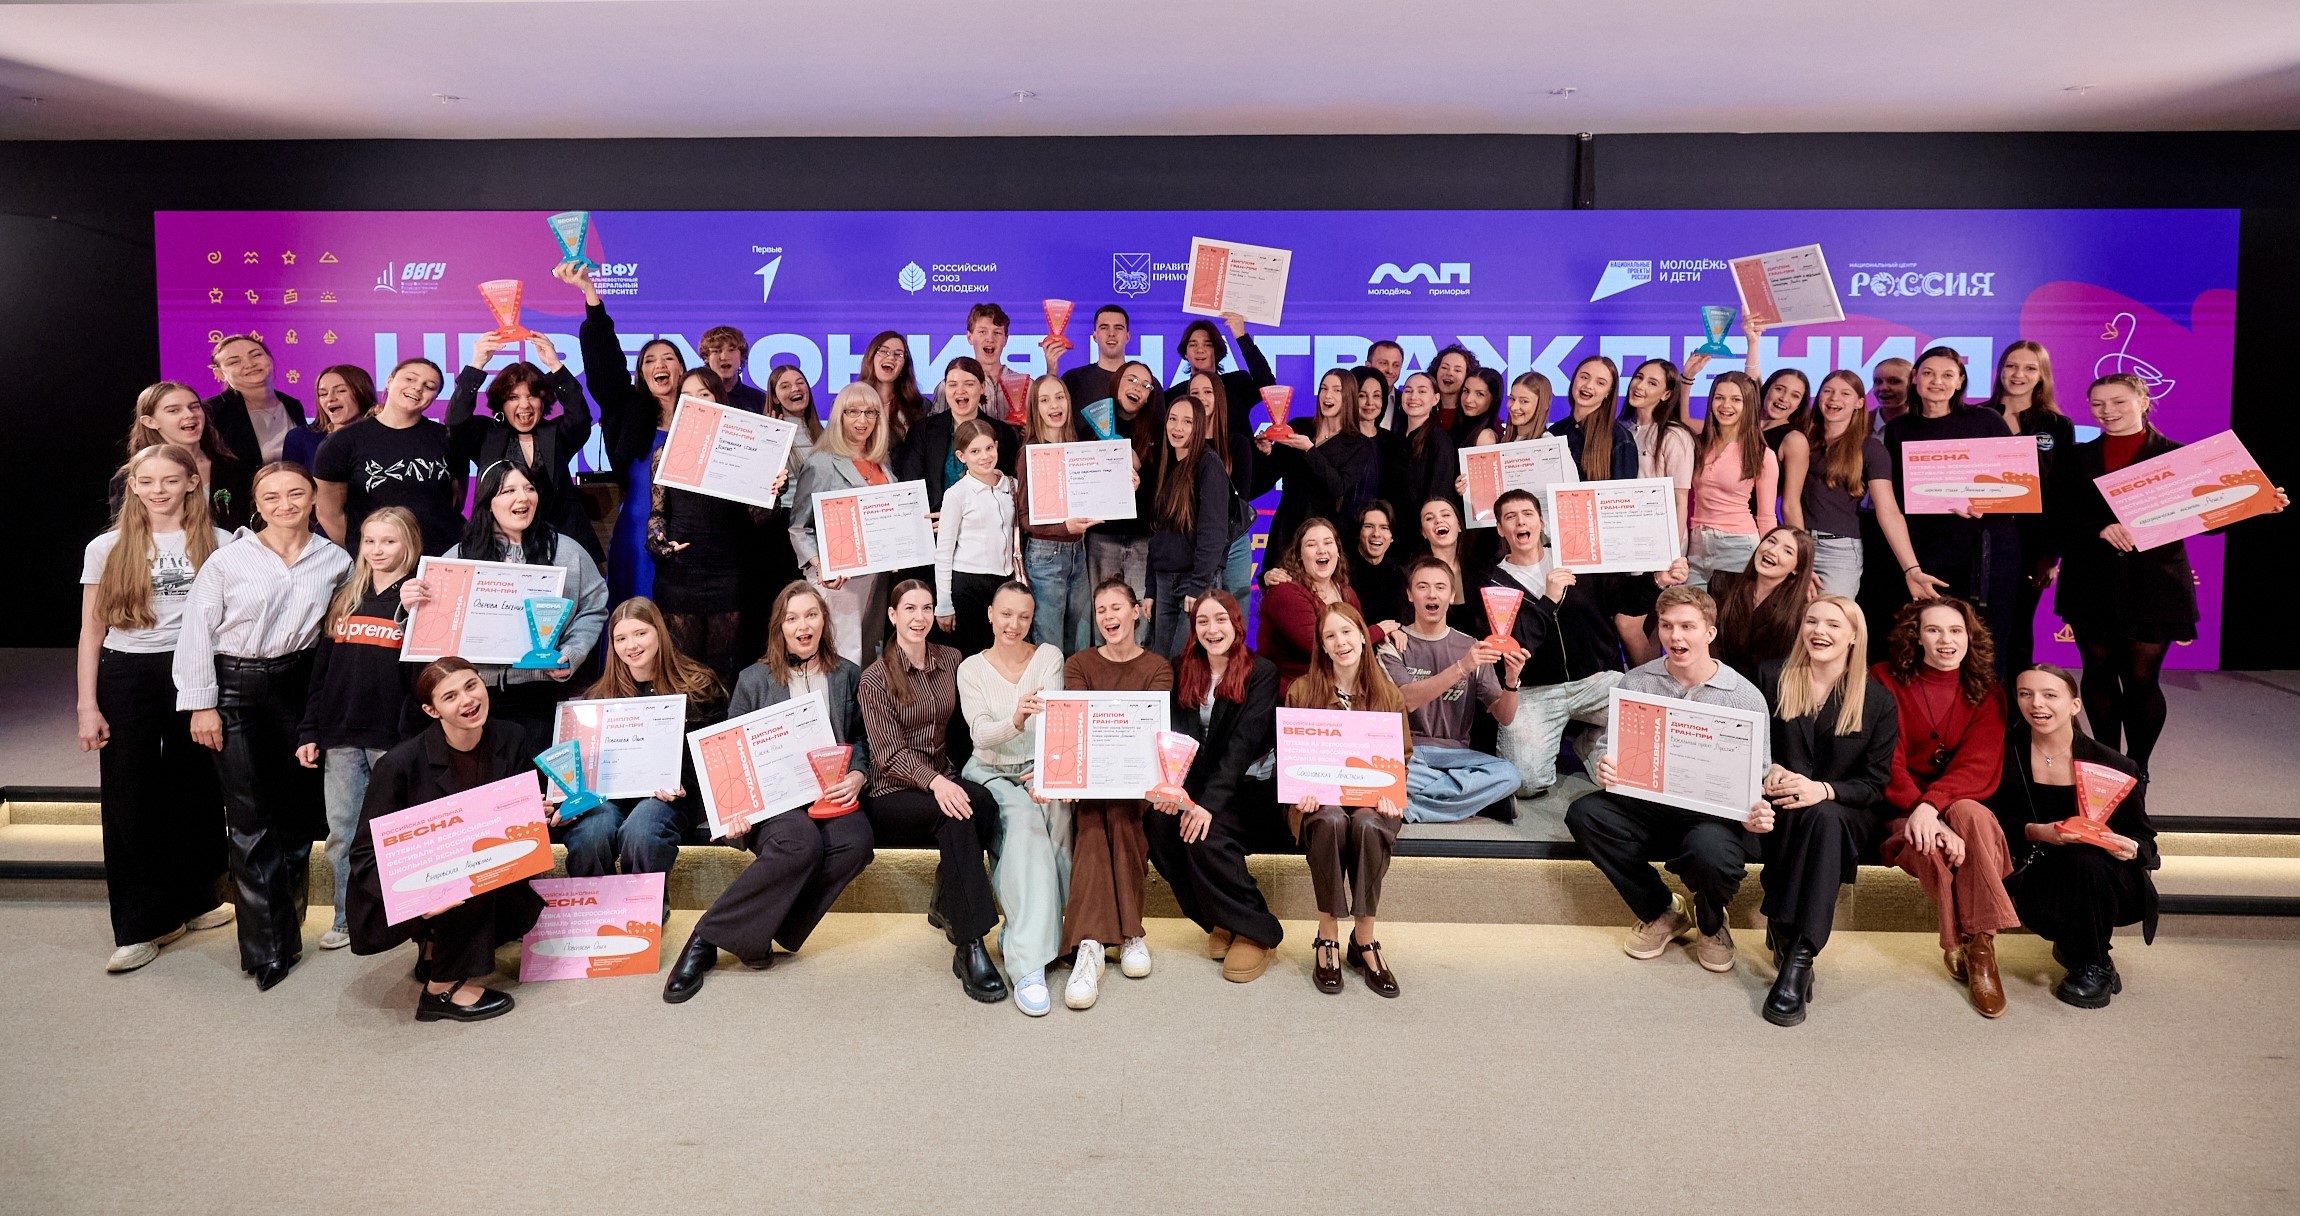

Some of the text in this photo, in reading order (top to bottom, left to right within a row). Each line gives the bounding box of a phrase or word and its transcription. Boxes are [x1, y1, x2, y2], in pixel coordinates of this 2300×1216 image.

[752, 245, 783, 255] Первые
[932, 263, 998, 273] РОССИЙСКИЙ
[1153, 262, 1190, 271] ПРАВИТ
[1660, 258, 1727, 271] МОЛОДЁЖЬ
[401, 262, 447, 280] ВВГУ
[1153, 272, 1189, 281] ПРИМО
[932, 274, 961, 283] СОЮЗ
[1660, 272, 1701, 283] И ДЕТИ
[932, 284, 989, 294] МОЛОДЕЖИ
[1848, 271, 1996, 297] РОССИЯ
[1368, 287, 1471, 296] молодёжь приморья
[722, 423, 753, 434] ДИПЛОМ
[721, 429, 755, 441] ГРАН-ПРИ
[1908, 453, 1970, 462] ВЕСНА
[2109, 470, 2176, 497] ВЕСНА
[863, 502, 890, 511] ДИПЛОМ
[863, 507, 895, 516] ГРАН-ПРИ
[850, 506, 863, 565] СТУДВЕСНА
[1586, 499, 1597, 561] СТУДВЕСНА
[451, 595, 465, 631] ВЕСНА
[336, 622, 402, 641] upreme
[751, 725, 784, 741] ДИПЛОМ
[1283, 727, 1342, 737] ВЕСНА
[1671, 721, 1708, 733] ДИПЛОМ
[752, 730, 789, 747] ГРАН-ПРИ
[1671, 728, 1713, 741] ГРАН-ПРИ
[1076, 711, 1084, 785] СТУДВЕСНА
[1652, 717, 1662, 789] СТУДВЕСНА
[735, 738, 760, 809] СТУДВЕСНА
[381, 807, 463, 837] РОССИЙСКАЯ ШКОЛЬНАЯ
[383, 815, 465, 848] ВЕСНА
[385, 816, 502, 860] ПУТЕВКА НА ВСЕРОССИЙСКИЙ
[386, 849, 434, 868] ФЕСТИВАЛЬ
[388, 858, 434, 877] ШКОЛЬНАЯ
[545, 896, 598, 908] ЕСНА
[539, 911, 561, 920] ТЕВКА
[573, 908, 627, 918] ВСЕРОССИЙСКИЙ
[536, 921, 569, 929] ЕСТИВАЛЬ
[530, 929, 567, 937] ШКОЛЬНАЯ
